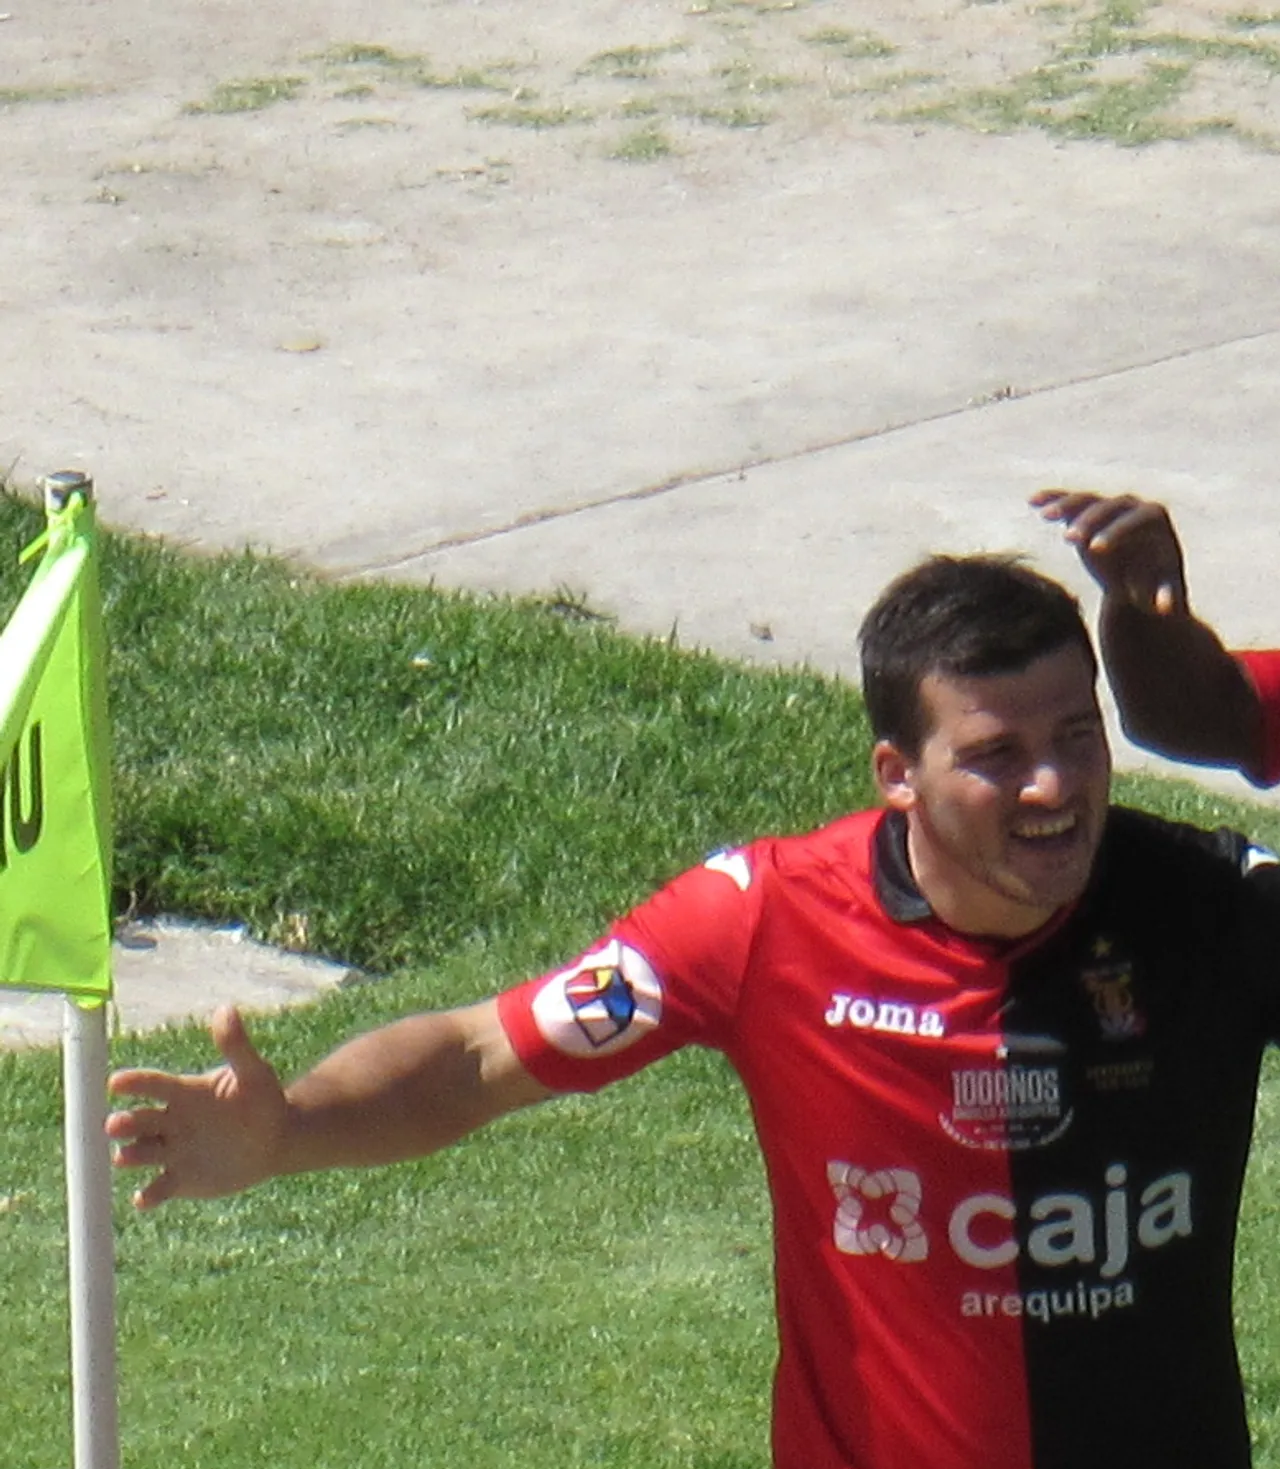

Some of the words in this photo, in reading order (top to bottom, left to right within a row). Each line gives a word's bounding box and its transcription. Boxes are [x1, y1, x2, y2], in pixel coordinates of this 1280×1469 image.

[825, 993, 945, 1038] Joma
[948, 1163, 1193, 1278] caja
[961, 1280, 1134, 1323] arequipa
